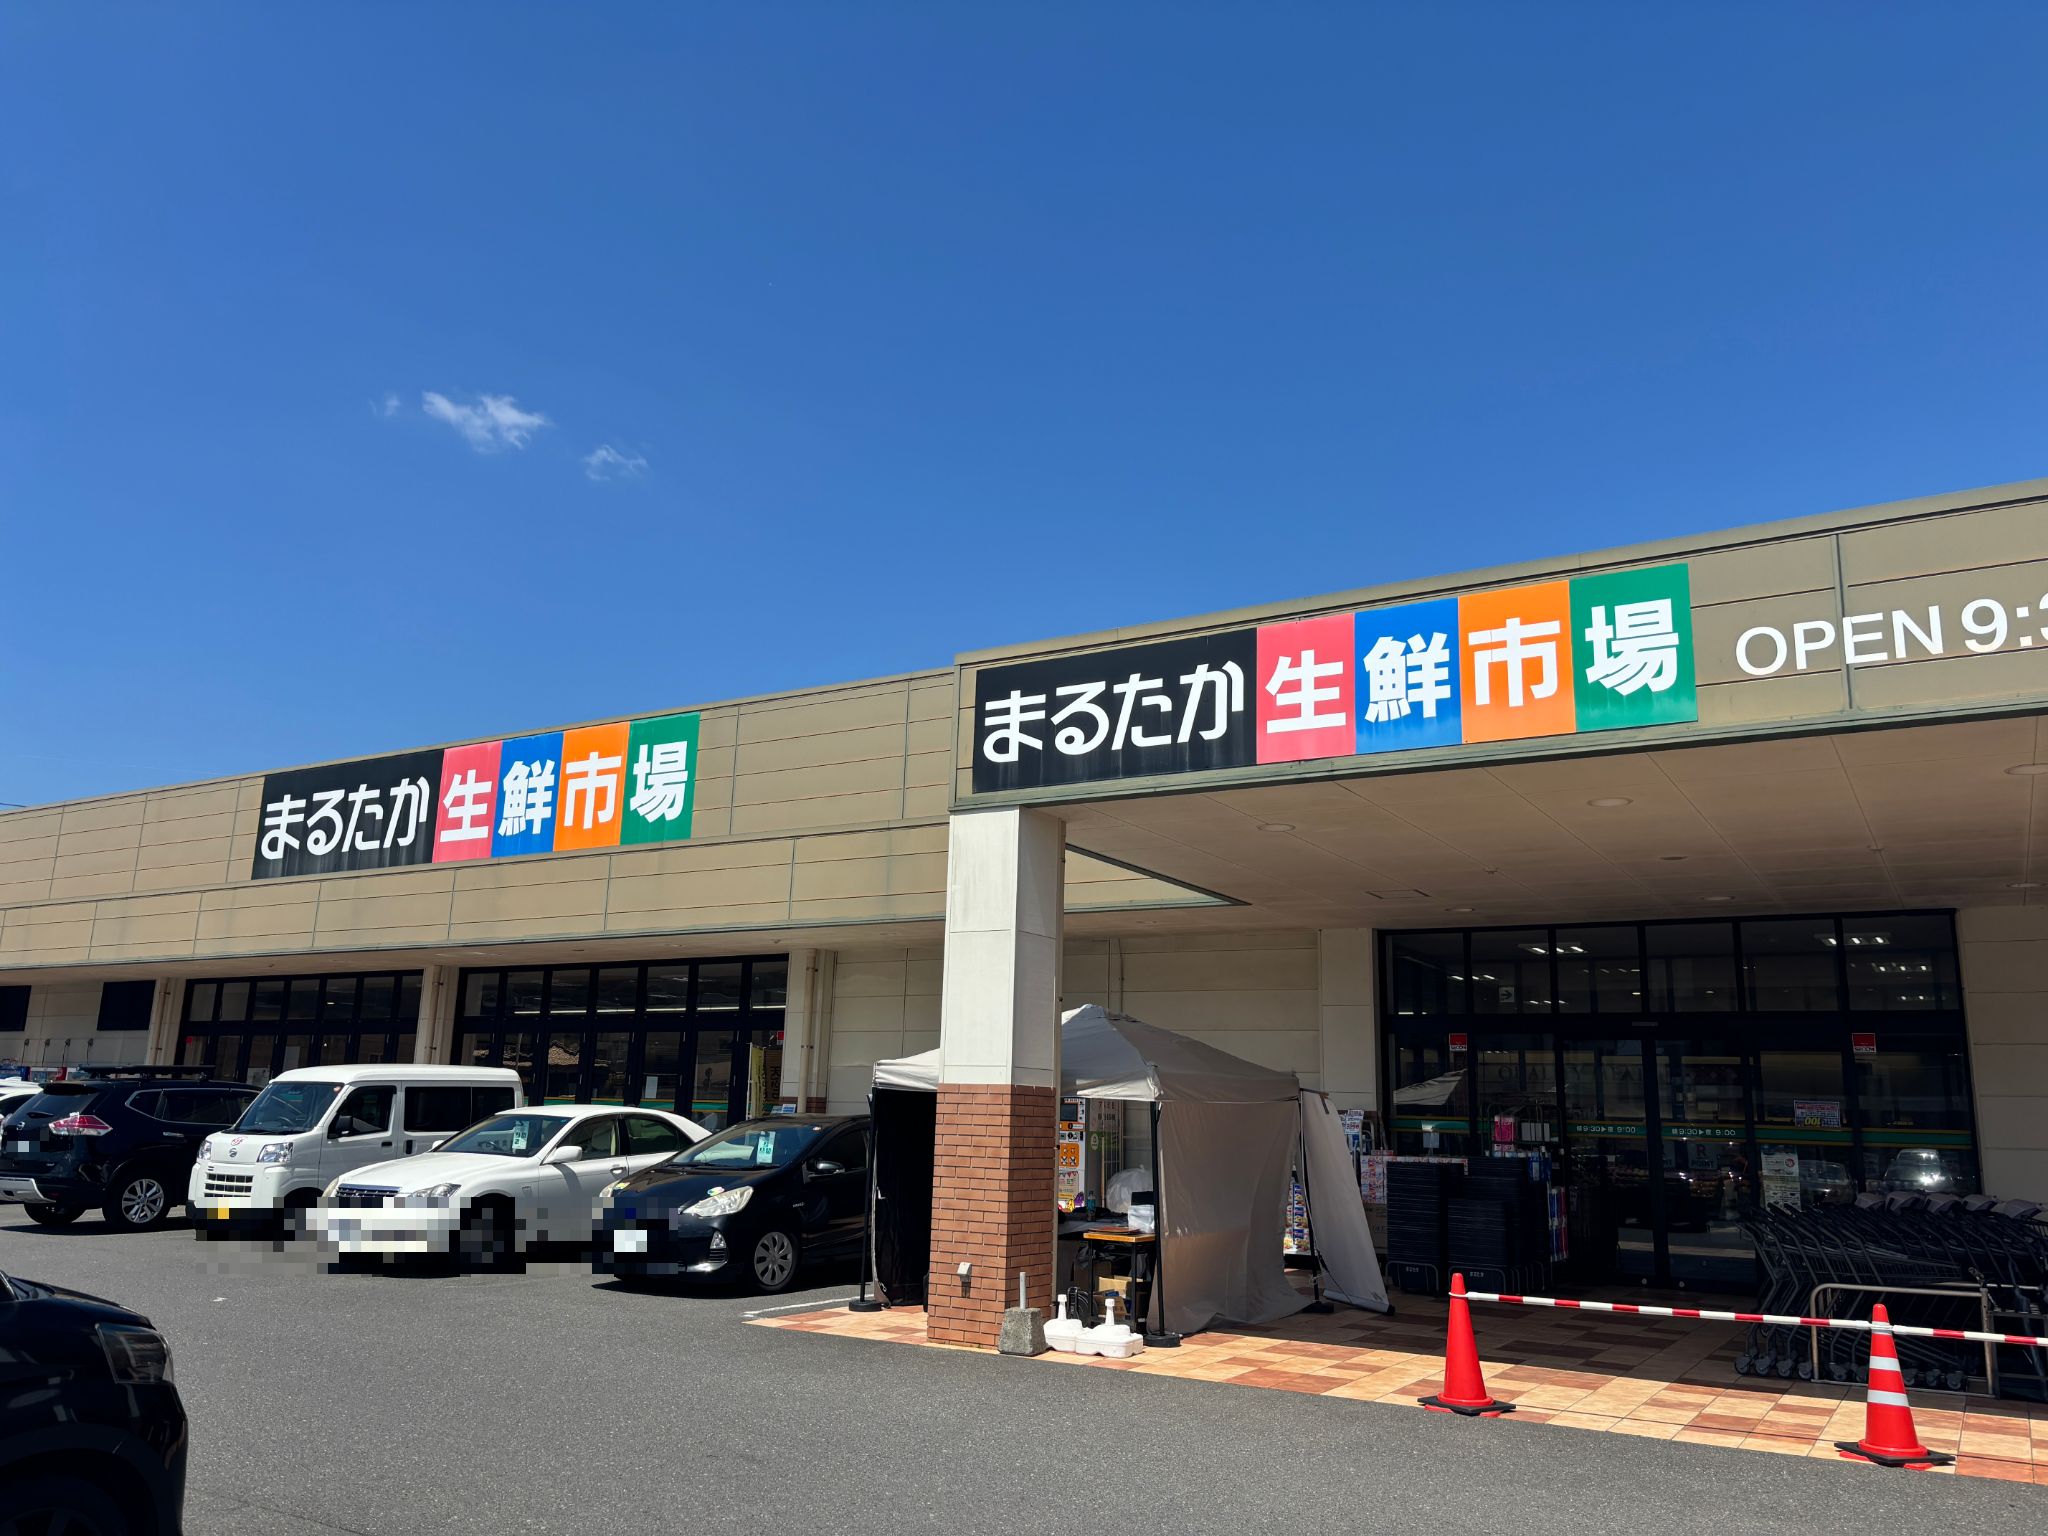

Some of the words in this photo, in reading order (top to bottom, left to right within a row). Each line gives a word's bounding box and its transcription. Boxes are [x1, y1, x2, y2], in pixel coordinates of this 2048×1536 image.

[983, 598, 1679, 763] まるたか生鮮市場
[1736, 605, 1943, 675] OPEN
[1961, 592, 2048, 653] 9:
[261, 741, 689, 860] まるたか生鮮市場
